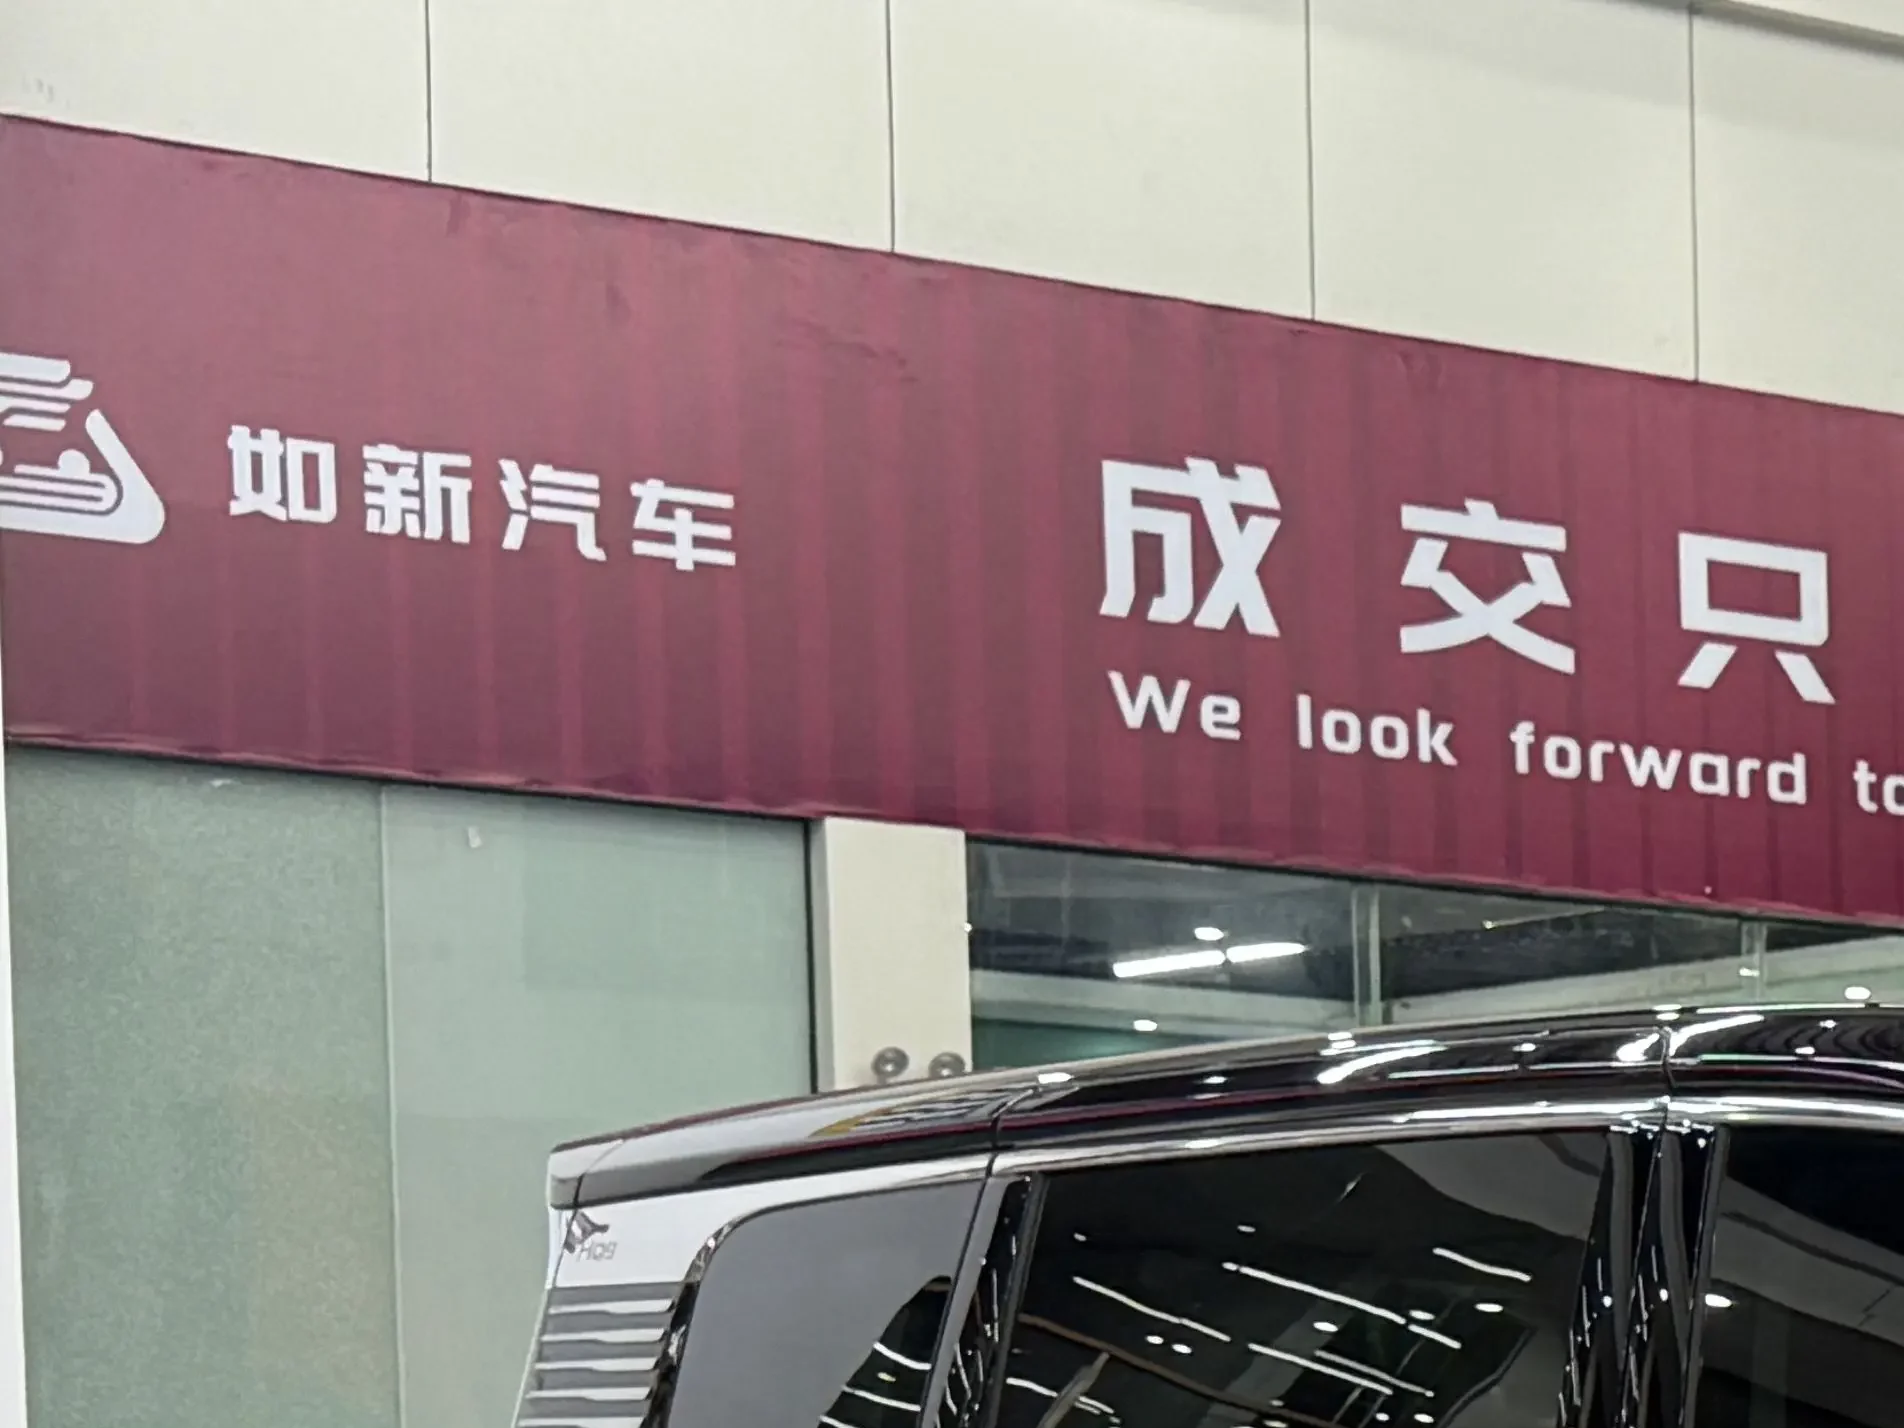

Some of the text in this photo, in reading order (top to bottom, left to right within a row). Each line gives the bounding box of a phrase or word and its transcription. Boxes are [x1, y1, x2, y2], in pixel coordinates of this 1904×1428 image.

[227, 424, 737, 572] 如新汽车
[1109, 671, 1242, 740] We
[1297, 693, 1457, 767] look
[1511, 720, 1806, 805] forward
